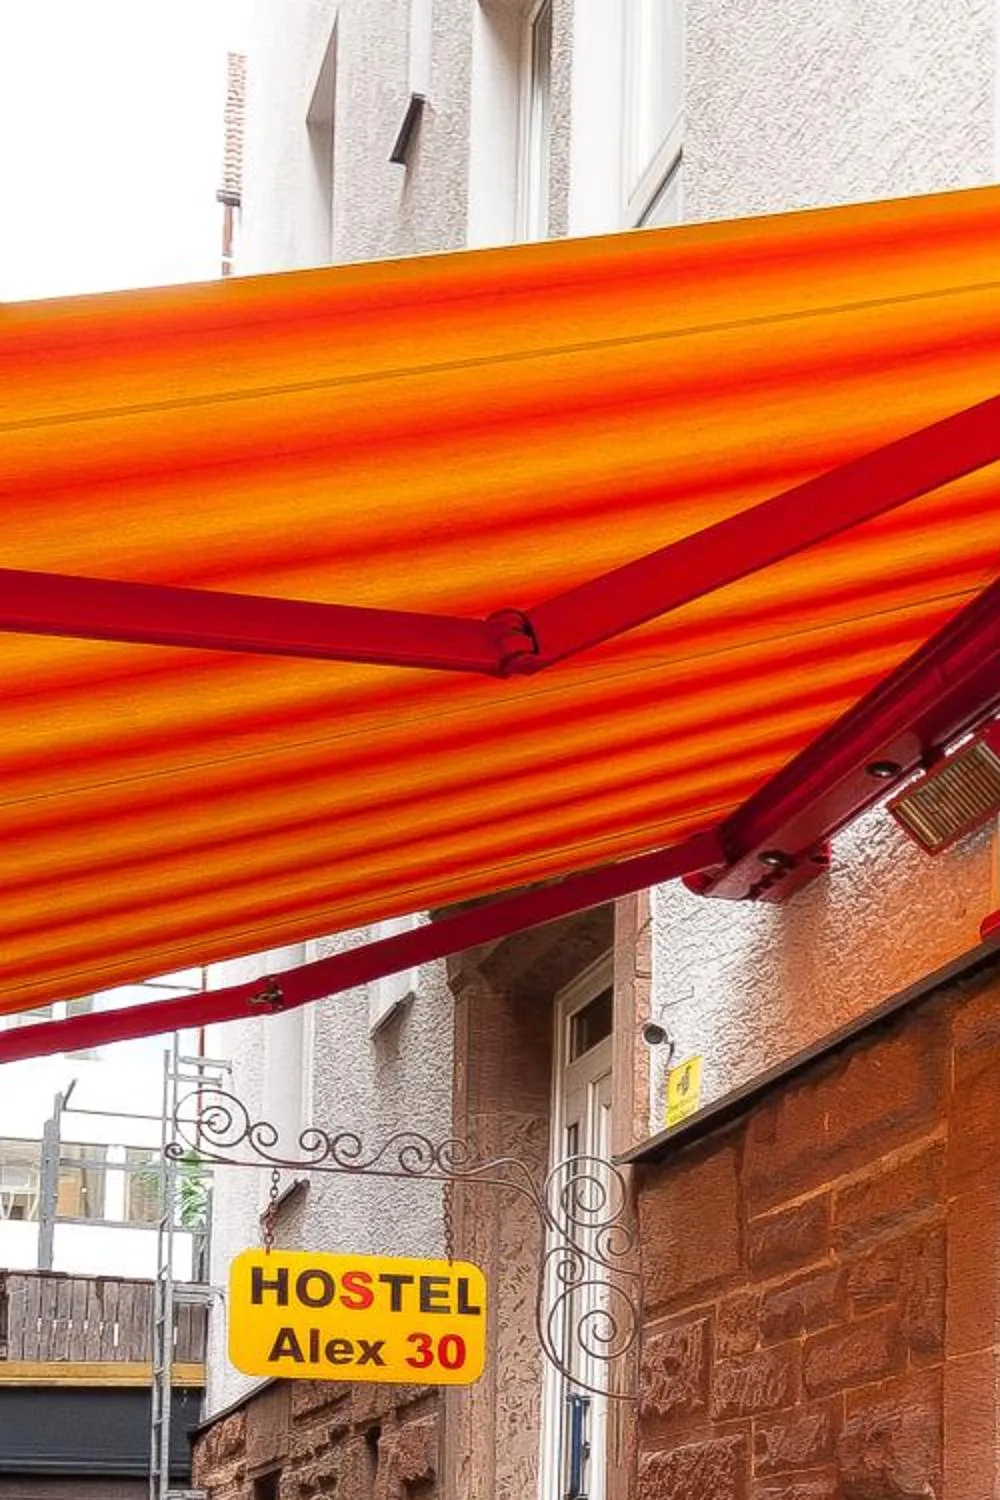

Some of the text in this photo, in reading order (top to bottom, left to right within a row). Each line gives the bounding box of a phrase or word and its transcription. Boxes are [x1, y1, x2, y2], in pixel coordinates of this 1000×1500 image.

[251, 1267, 481, 1315] HOSTEL
[267, 1327, 466, 1370] Alex 30
